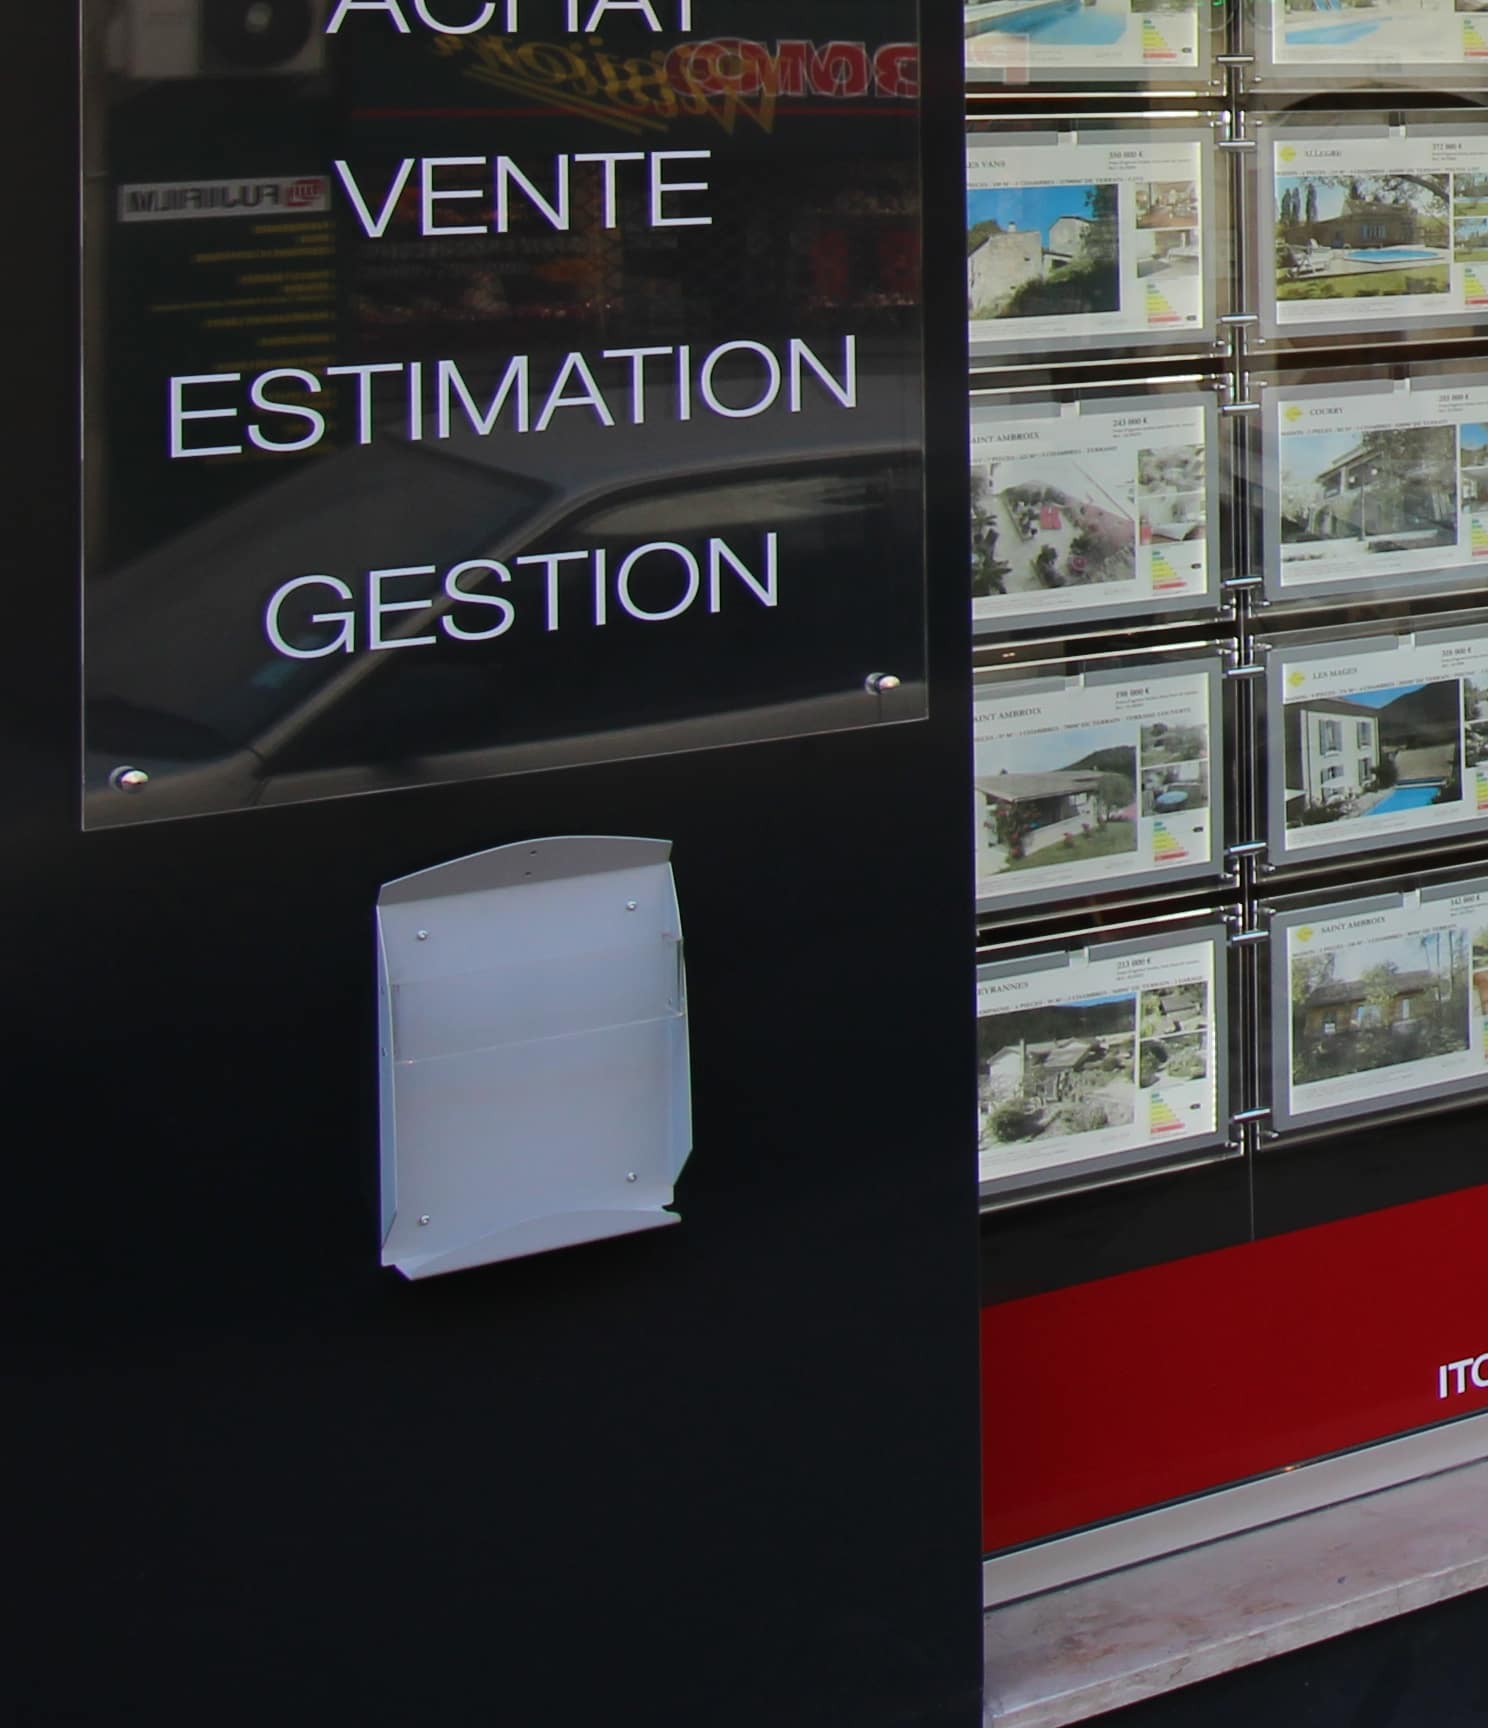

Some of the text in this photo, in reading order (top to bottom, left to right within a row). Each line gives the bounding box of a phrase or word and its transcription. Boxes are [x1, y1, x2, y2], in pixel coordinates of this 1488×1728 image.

[335, 150, 712, 238] VENTE
[170, 335, 857, 459] ESTIMATION
[265, 532, 778, 659] GESTION
